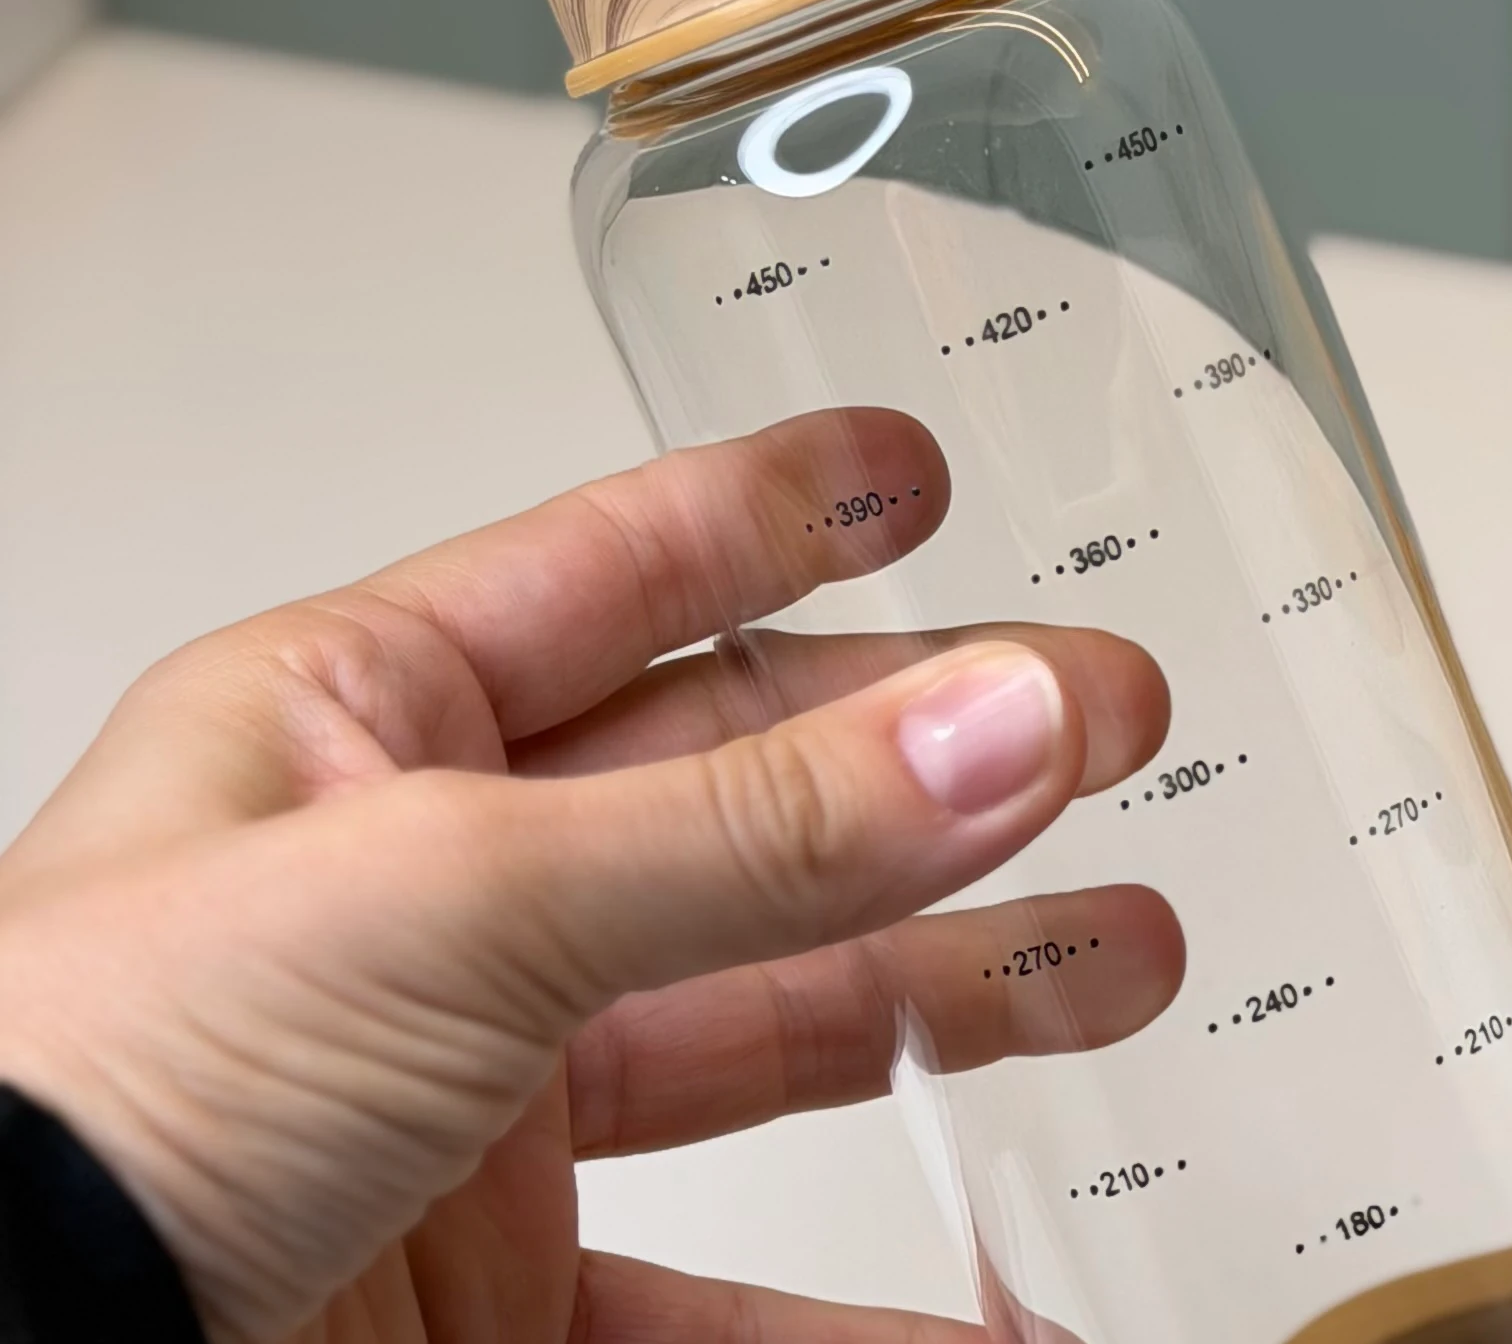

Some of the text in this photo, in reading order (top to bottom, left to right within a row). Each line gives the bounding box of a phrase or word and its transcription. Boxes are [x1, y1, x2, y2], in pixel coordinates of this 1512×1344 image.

[1117, 126, 1158, 160] 450
[745, 262, 793, 297] 450
[981, 307, 1033, 344] 420
[1204, 352, 1247, 390] 390
[835, 491, 884, 528] 390
[1069, 535, 1122, 574] 360
[1292, 576, 1332, 613] 330
[1158, 759, 1211, 799] 300
[1378, 797, 1419, 836] 270
[1013, 941, 1062, 977] 270
[1245, 983, 1299, 1023] 240
[1464, 1015, 1504, 1055] 210
[1100, 1162, 1149, 1198] 210
[1335, 1205, 1386, 1242] 180
